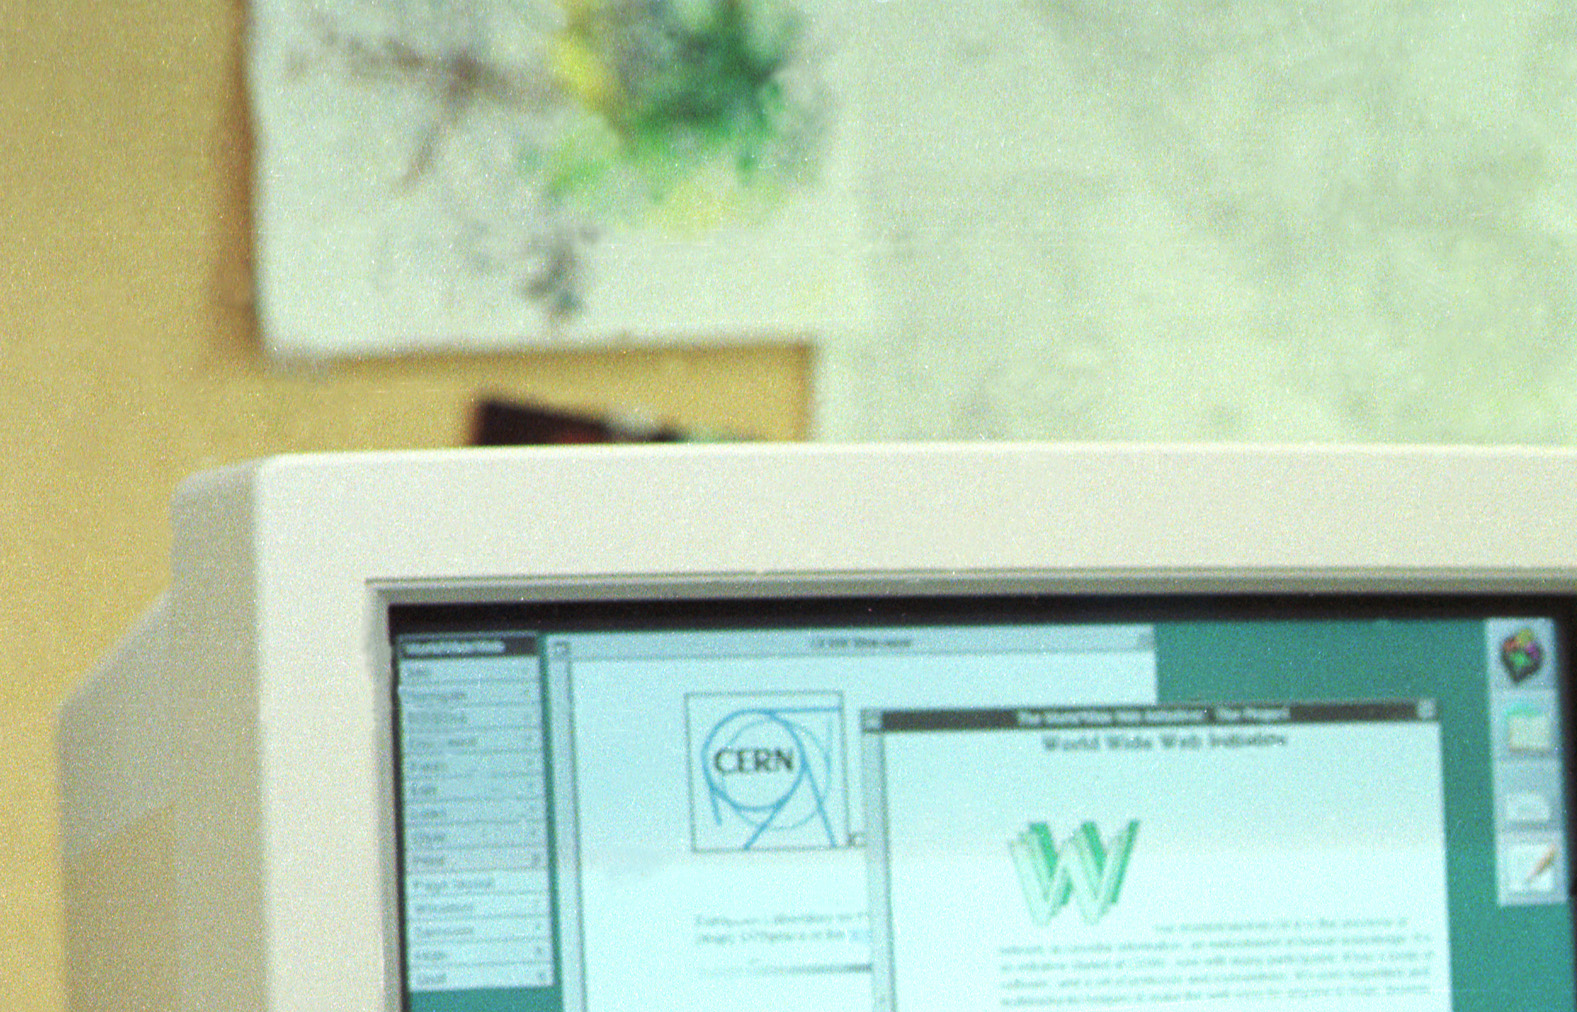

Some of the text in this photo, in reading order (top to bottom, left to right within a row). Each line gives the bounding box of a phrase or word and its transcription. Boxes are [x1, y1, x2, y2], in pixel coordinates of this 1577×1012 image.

[1042, 735, 1099, 752] World
[1106, 734, 1153, 751] Wide
[1159, 733, 1202, 750] Web
[714, 747, 793, 774] CERN
